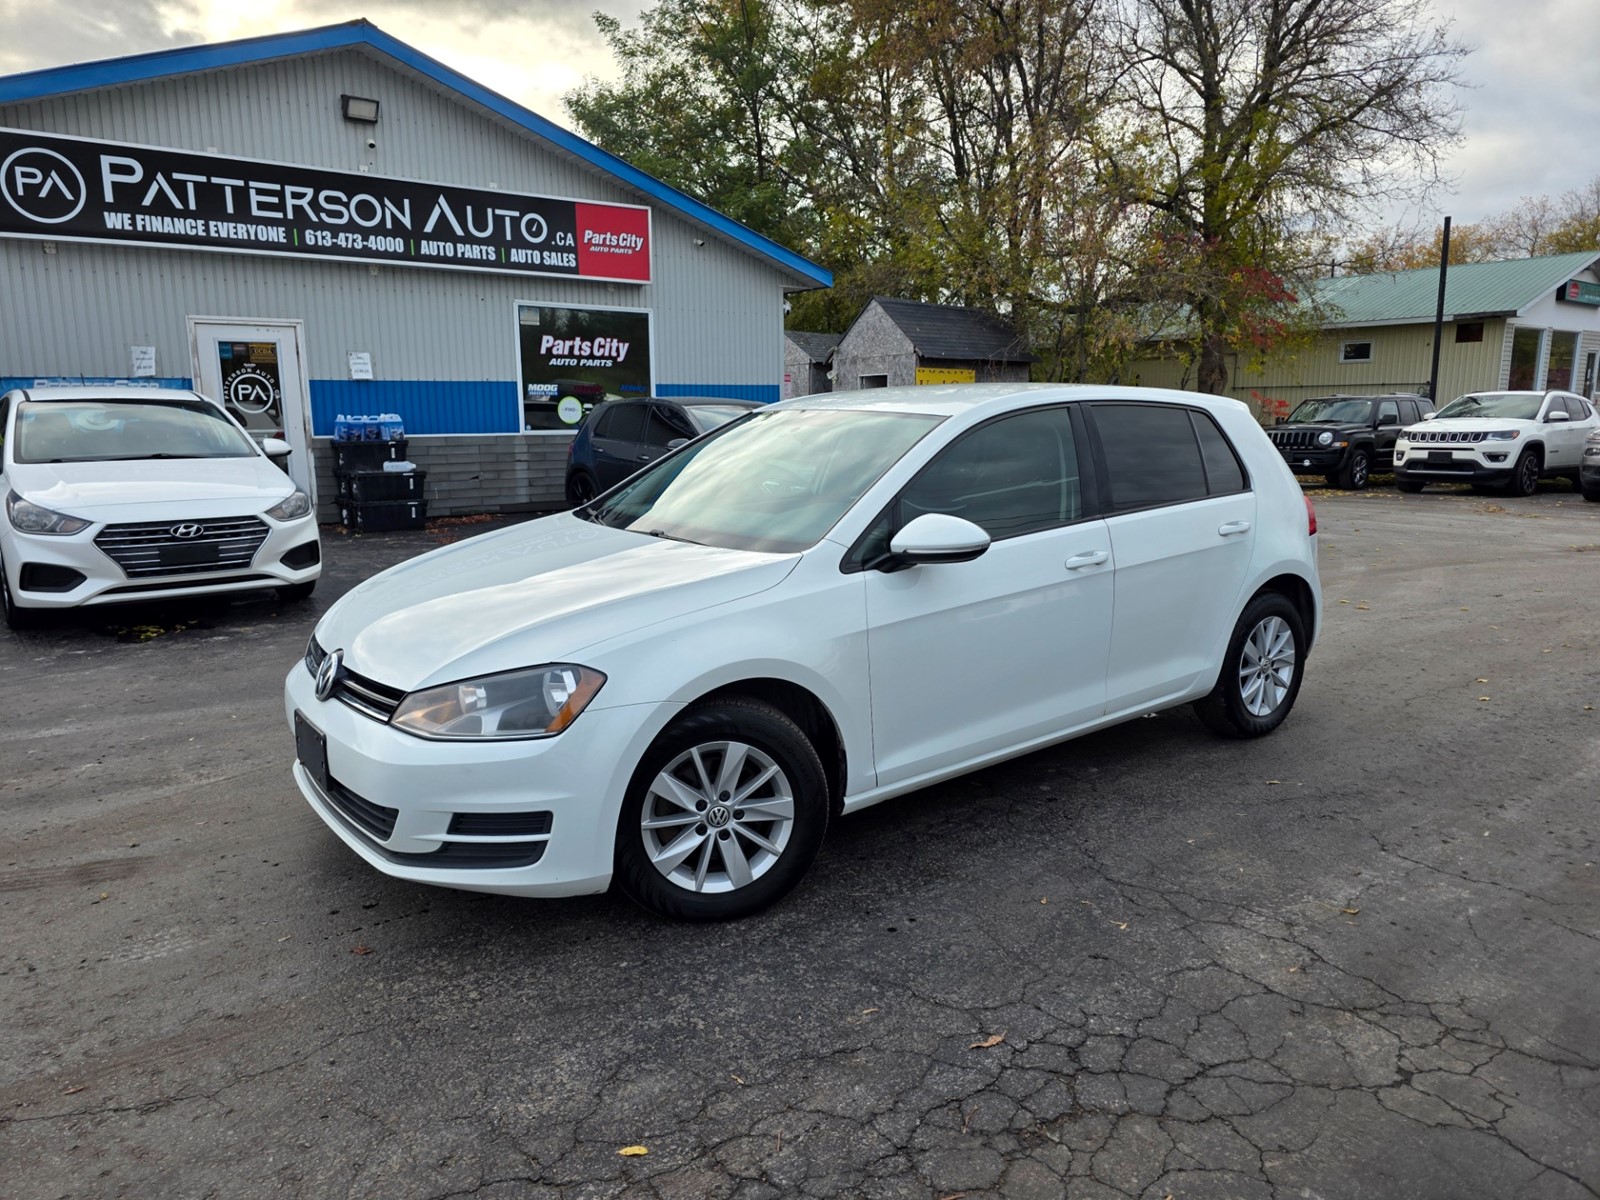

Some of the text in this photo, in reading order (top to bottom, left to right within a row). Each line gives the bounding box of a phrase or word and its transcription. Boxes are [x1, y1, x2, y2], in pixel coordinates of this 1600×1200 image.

[100, 153, 412, 231] PATTERSON
[103, 211, 577, 268] WE FINANCE EVERYONE 613-473-4000 AUTO PARTS AUTO SALES
[611, 247, 633, 255] PARTS
[549, 358, 613, 367] AUTO PARTS
[224, 368, 252, 400] PATTERSON
[527, 384, 558, 392] MOOG
